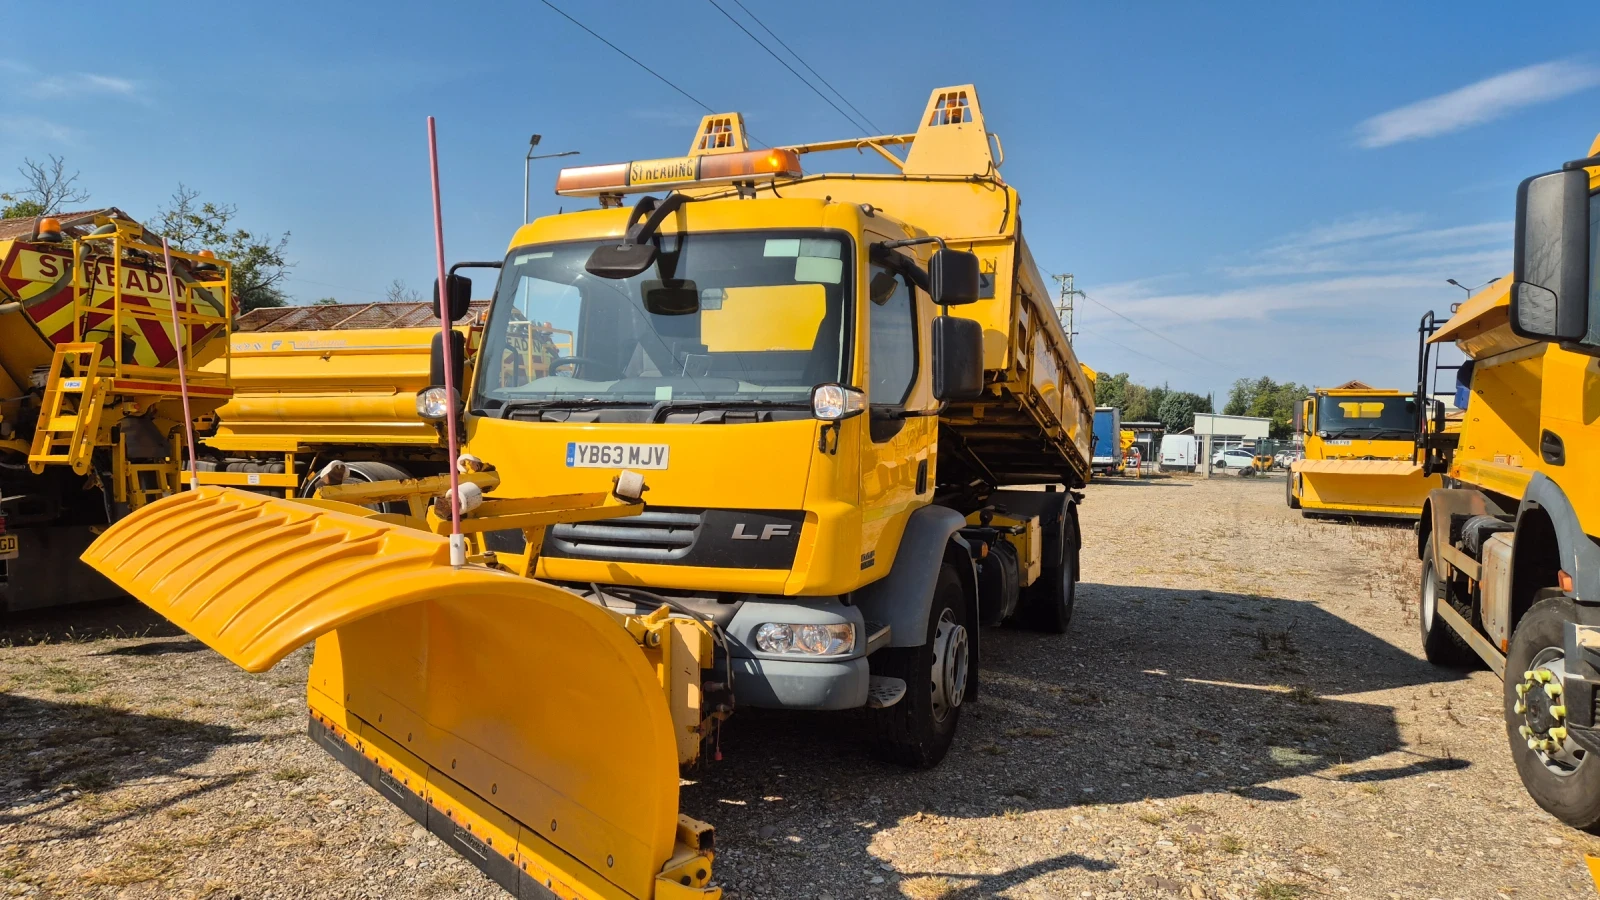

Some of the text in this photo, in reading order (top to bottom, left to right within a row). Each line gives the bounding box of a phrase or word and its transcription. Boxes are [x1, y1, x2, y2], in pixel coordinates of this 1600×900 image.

[578, 445, 665, 466] YB63 MJV
[731, 523, 792, 540] LF
